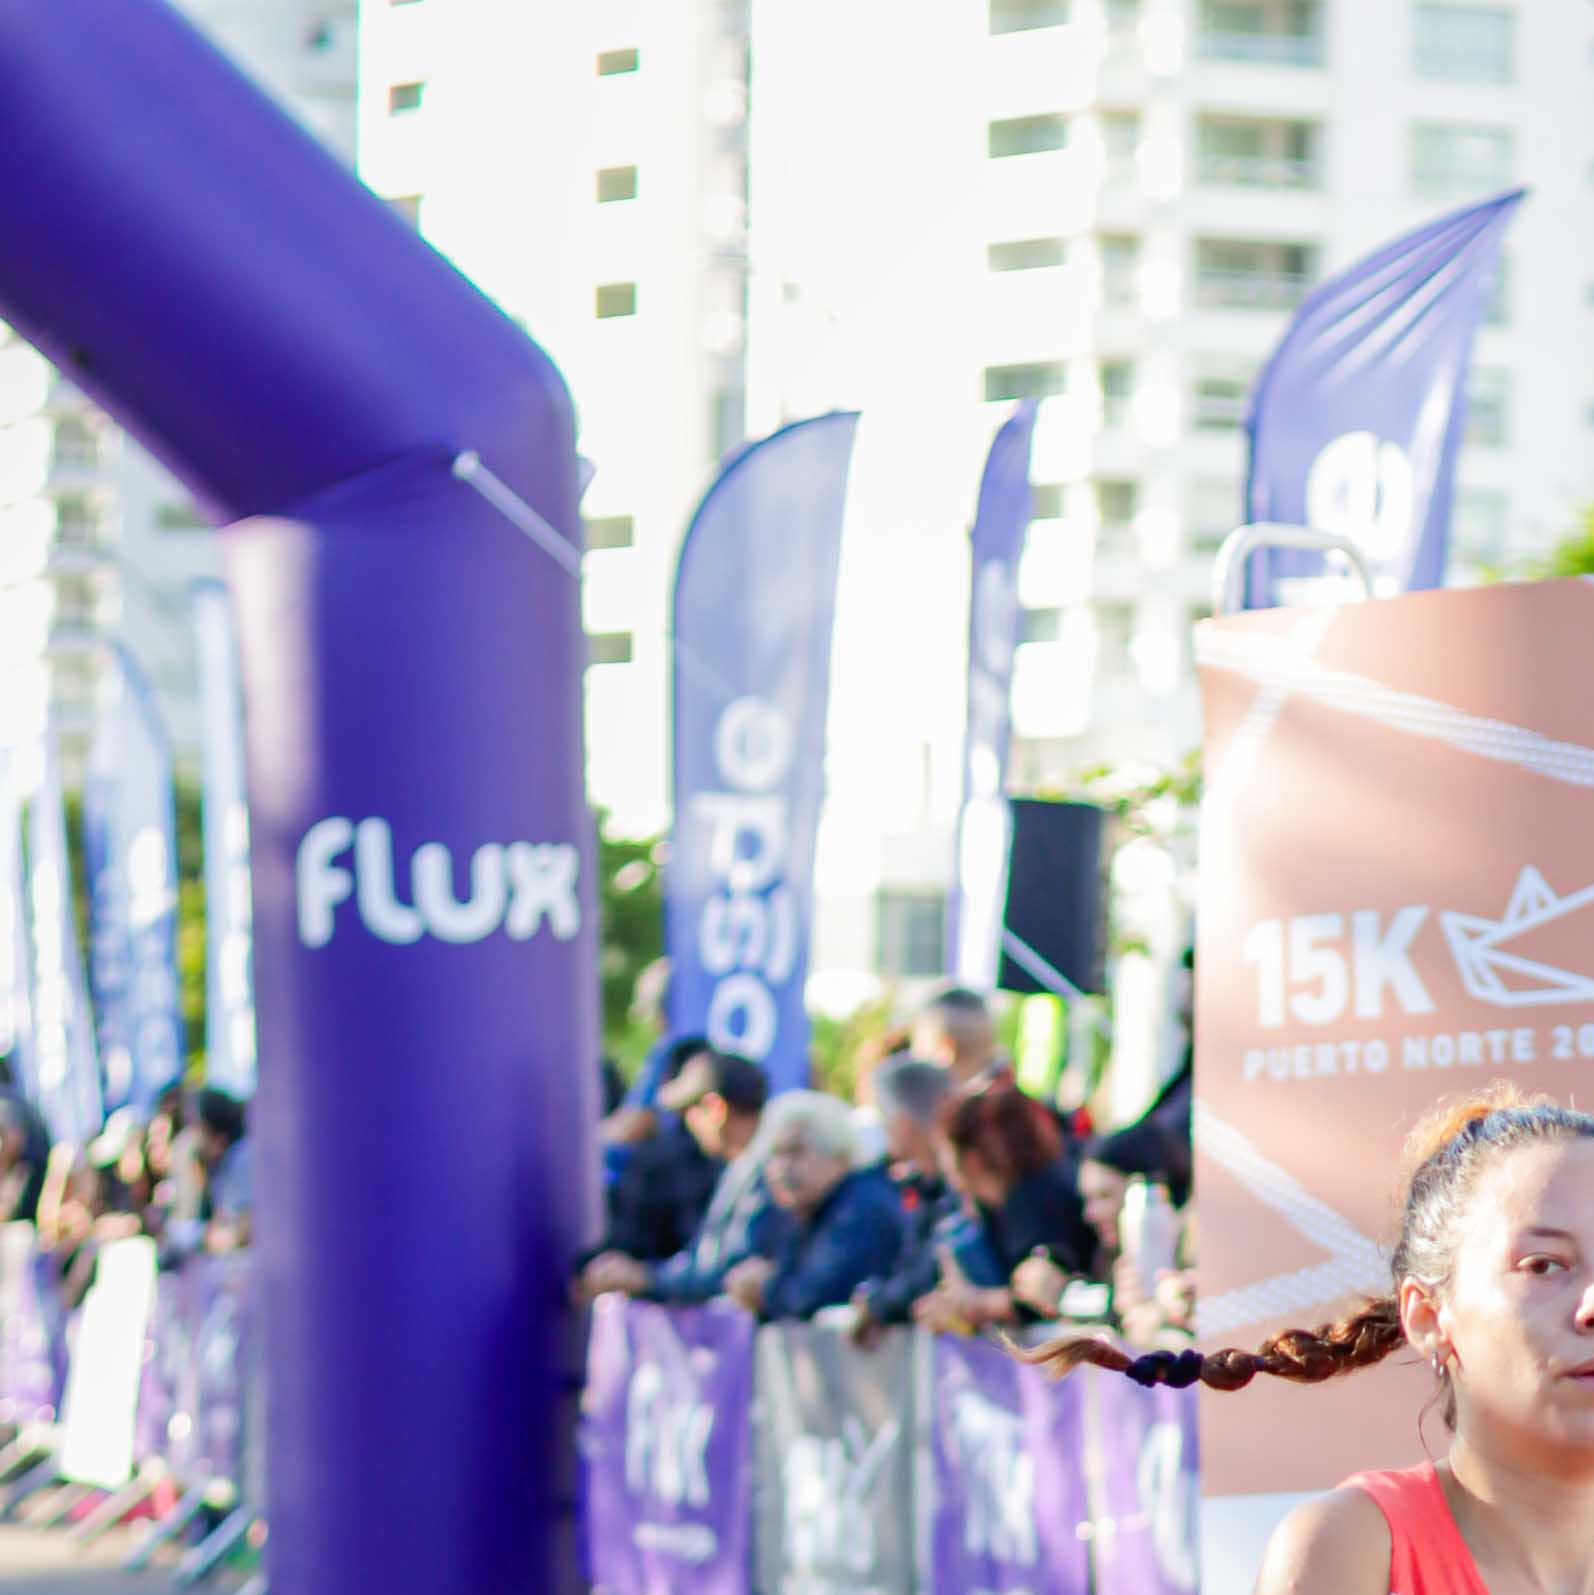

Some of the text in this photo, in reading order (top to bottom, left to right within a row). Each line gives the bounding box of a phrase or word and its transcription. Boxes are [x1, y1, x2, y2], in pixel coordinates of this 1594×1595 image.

[1243, 904, 1437, 1027] 15K
[1244, 1040, 1388, 1083] PUERTO
[1403, 1028, 1535, 1068] NORTE
